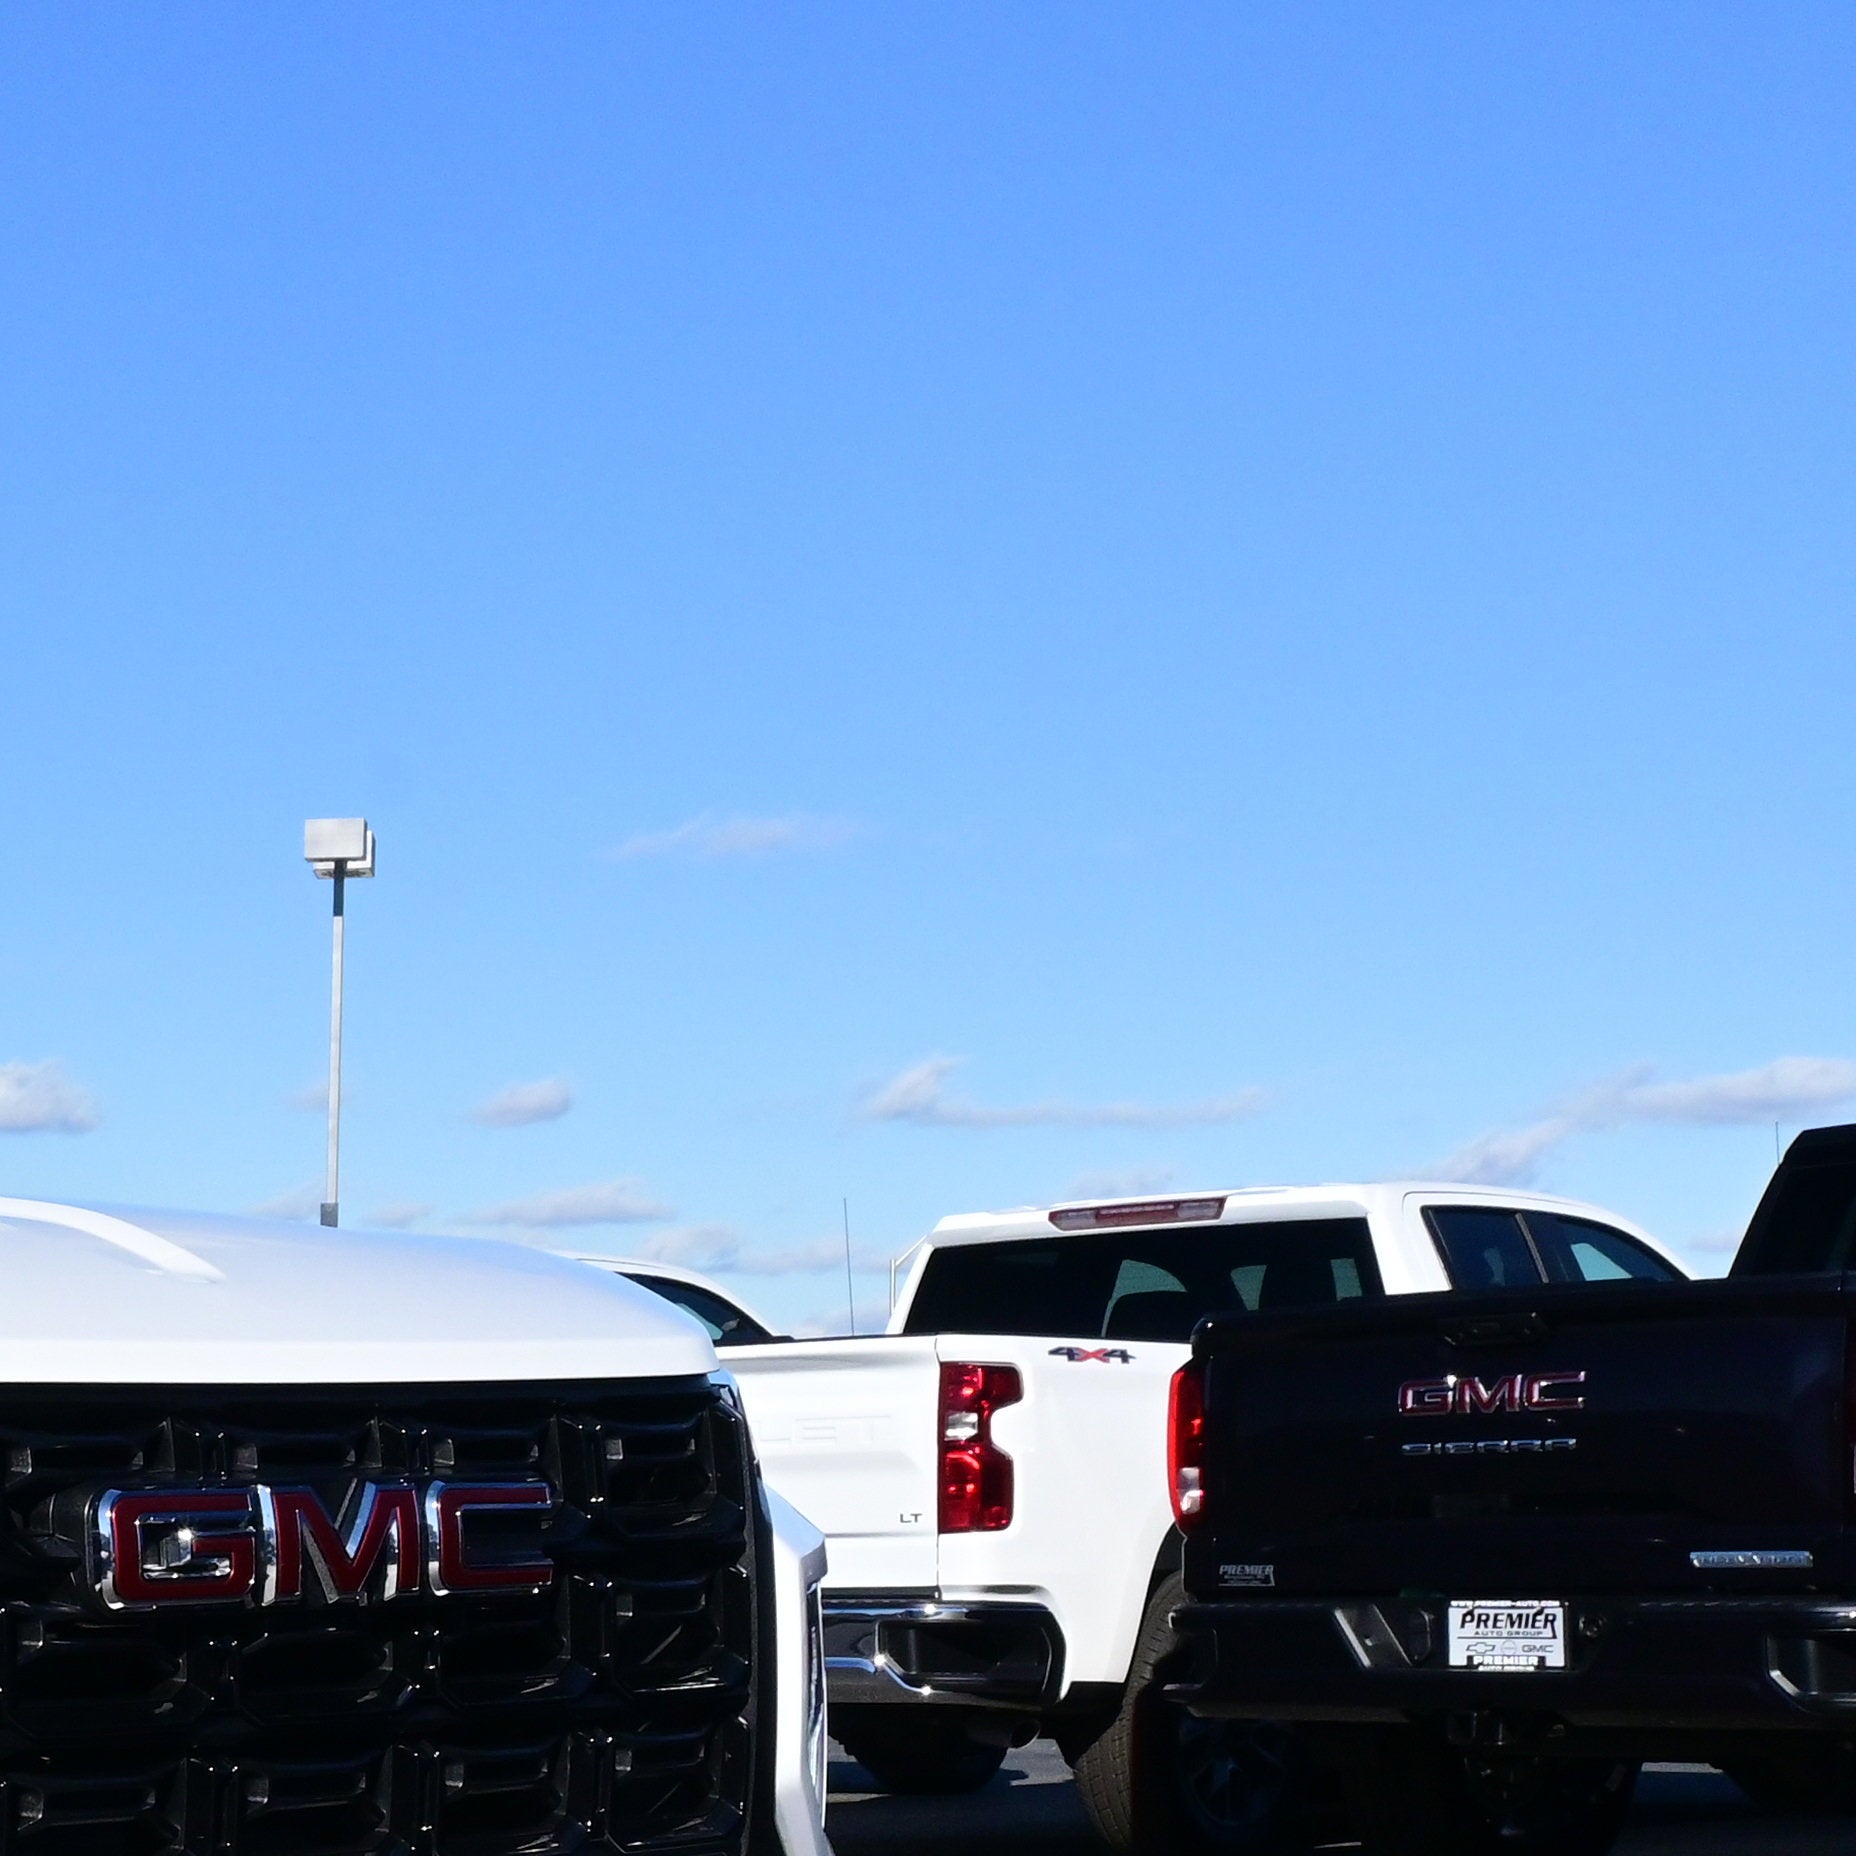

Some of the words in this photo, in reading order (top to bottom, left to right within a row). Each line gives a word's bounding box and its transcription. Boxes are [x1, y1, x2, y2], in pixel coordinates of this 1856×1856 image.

[1398, 1371, 1586, 1416] GMC
[1402, 1438, 1576, 1455] SIERRA
[900, 1513, 923, 1523] LT
[96, 1479, 554, 1608] GMC
[1459, 1612, 1557, 1638] PREMIER
[1521, 1645, 1554, 1653] GMC
[1473, 1655, 1539, 1666] PREMIER
